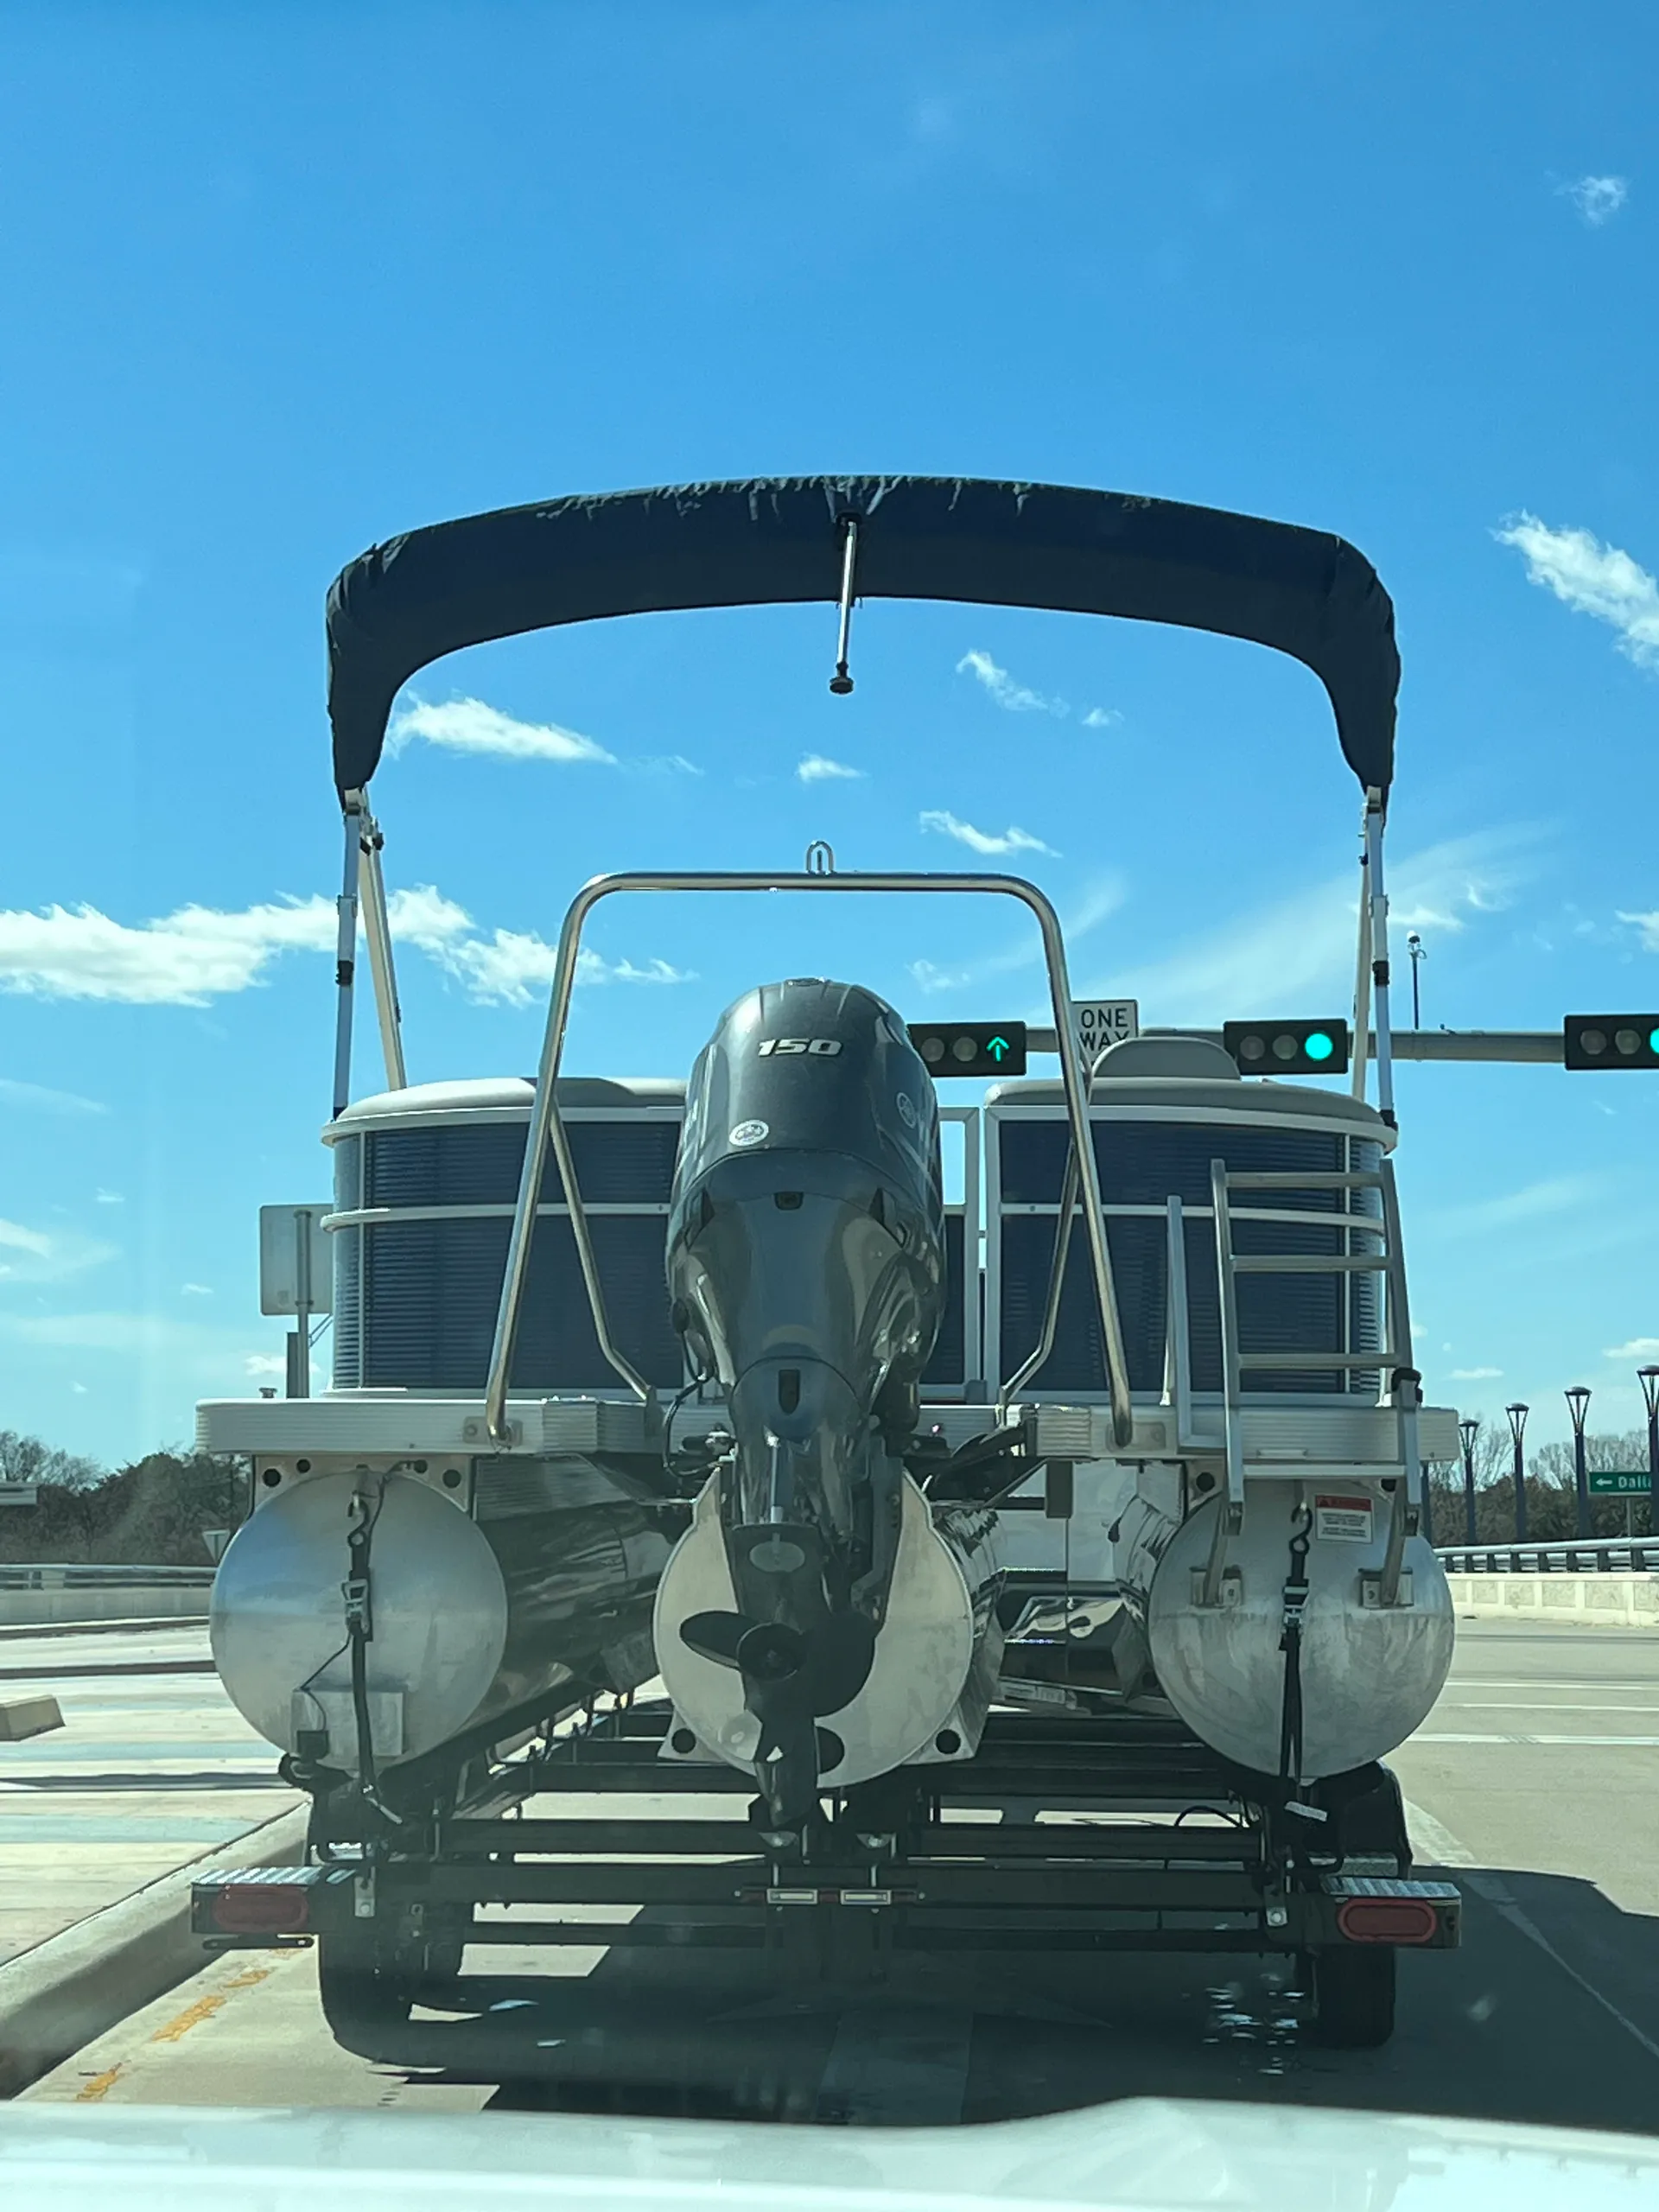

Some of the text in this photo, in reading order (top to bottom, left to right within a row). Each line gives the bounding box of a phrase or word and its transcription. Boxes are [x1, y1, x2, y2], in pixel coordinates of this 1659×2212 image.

[1081, 1007, 1128, 1028] ONE
[758, 1039, 842, 1056] 150
[1079, 1030, 1129, 1051] WAY
